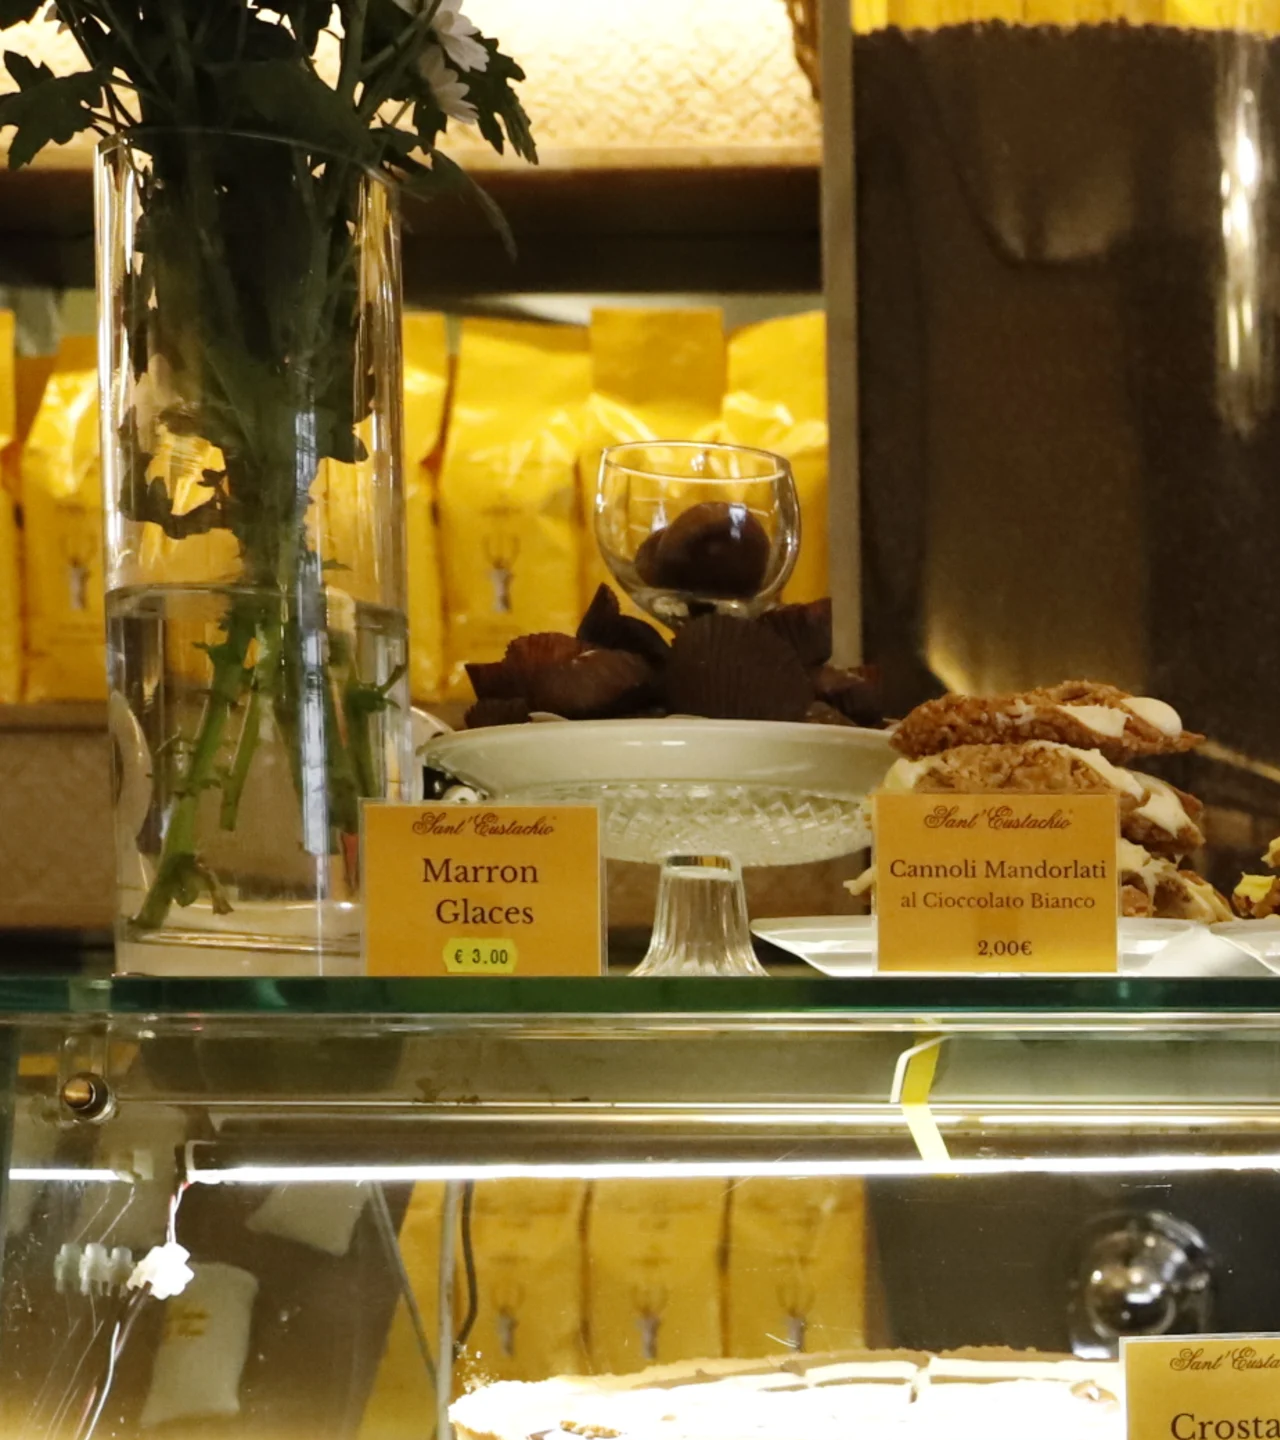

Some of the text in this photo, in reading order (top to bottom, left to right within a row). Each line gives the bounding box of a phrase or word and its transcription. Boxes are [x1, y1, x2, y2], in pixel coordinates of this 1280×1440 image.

[423, 857, 540, 884] Marron
[890, 858, 1106, 880] Cannoli Mandorlati
[901, 892, 1096, 909] al Cioccolato Bianco
[435, 898, 534, 925] Glaces
[454, 948, 510, 966] € 3.00
[978, 940, 1033, 958] 2,00€
